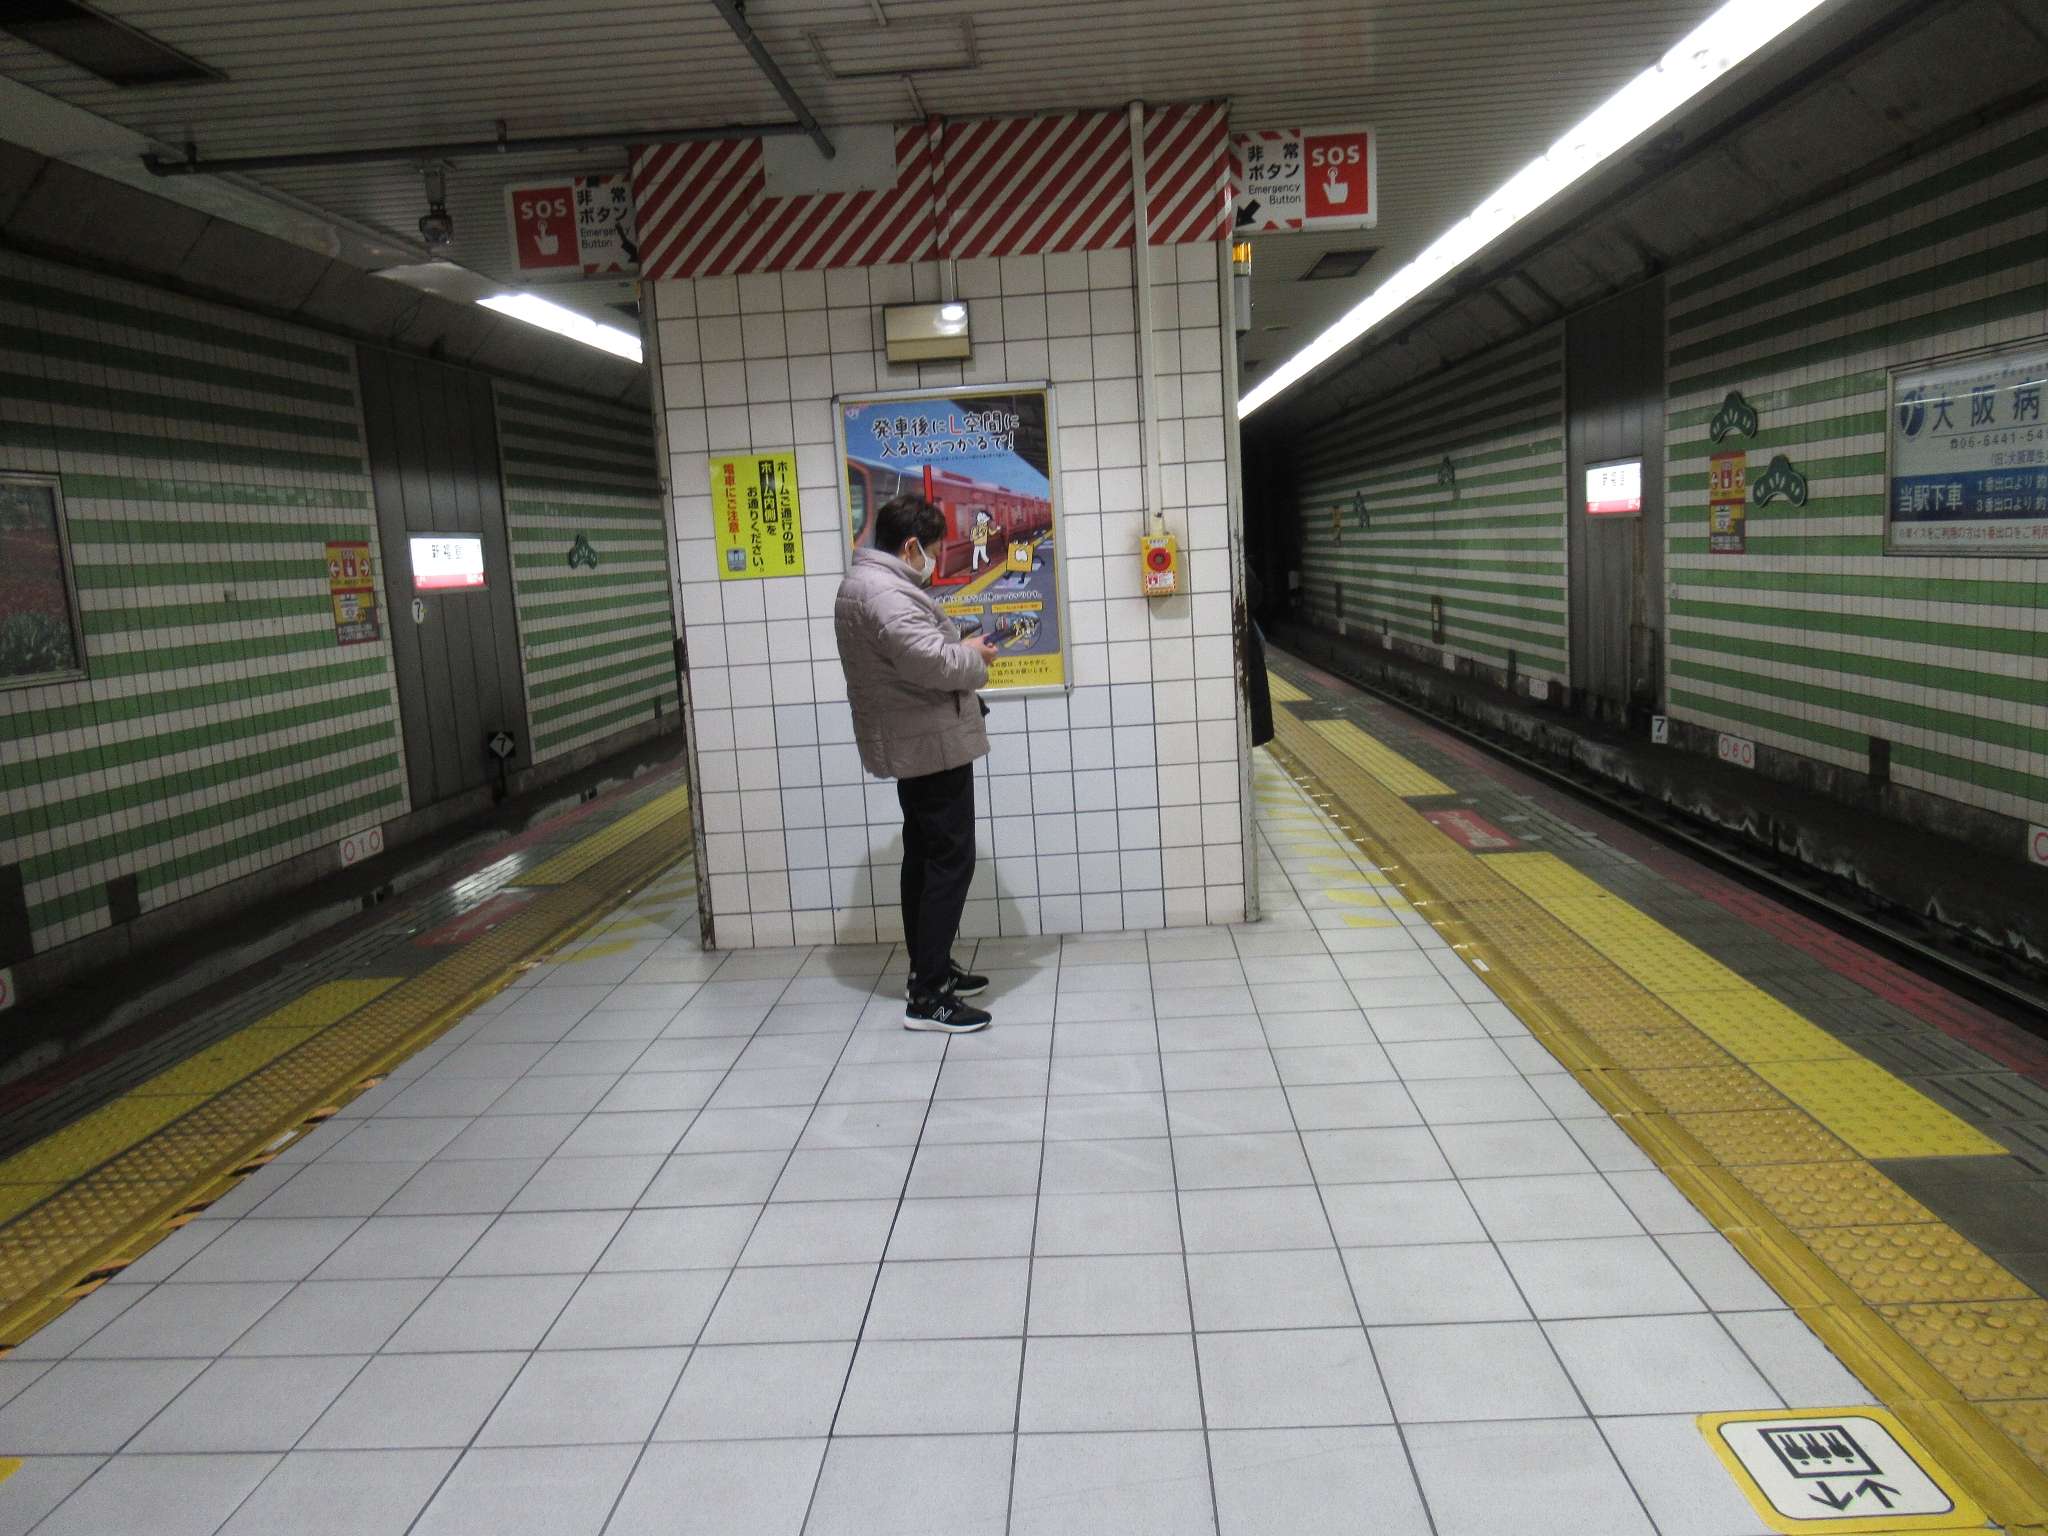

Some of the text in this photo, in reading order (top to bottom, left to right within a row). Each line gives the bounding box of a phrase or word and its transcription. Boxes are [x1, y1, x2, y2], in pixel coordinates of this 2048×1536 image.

[1312, 145, 1360, 167] SOS
[1249, 163, 1300, 181] ボタン
[1248, 183, 1300, 196] Emergency
[1269, 194, 1301, 205] Button
[520, 198, 567, 220] SOS
[580, 206, 628, 224] ボタン
[873, 411, 1020, 440] 発車後にL空間に
[760, 461, 777, 536] ホーム内側を
[1898, 481, 1963, 513] 当駅下車
[778, 461, 795, 565] ホームご通行の際は
[747, 486, 764, 573] お通りください。
[1655, 718, 1665, 733] 7
